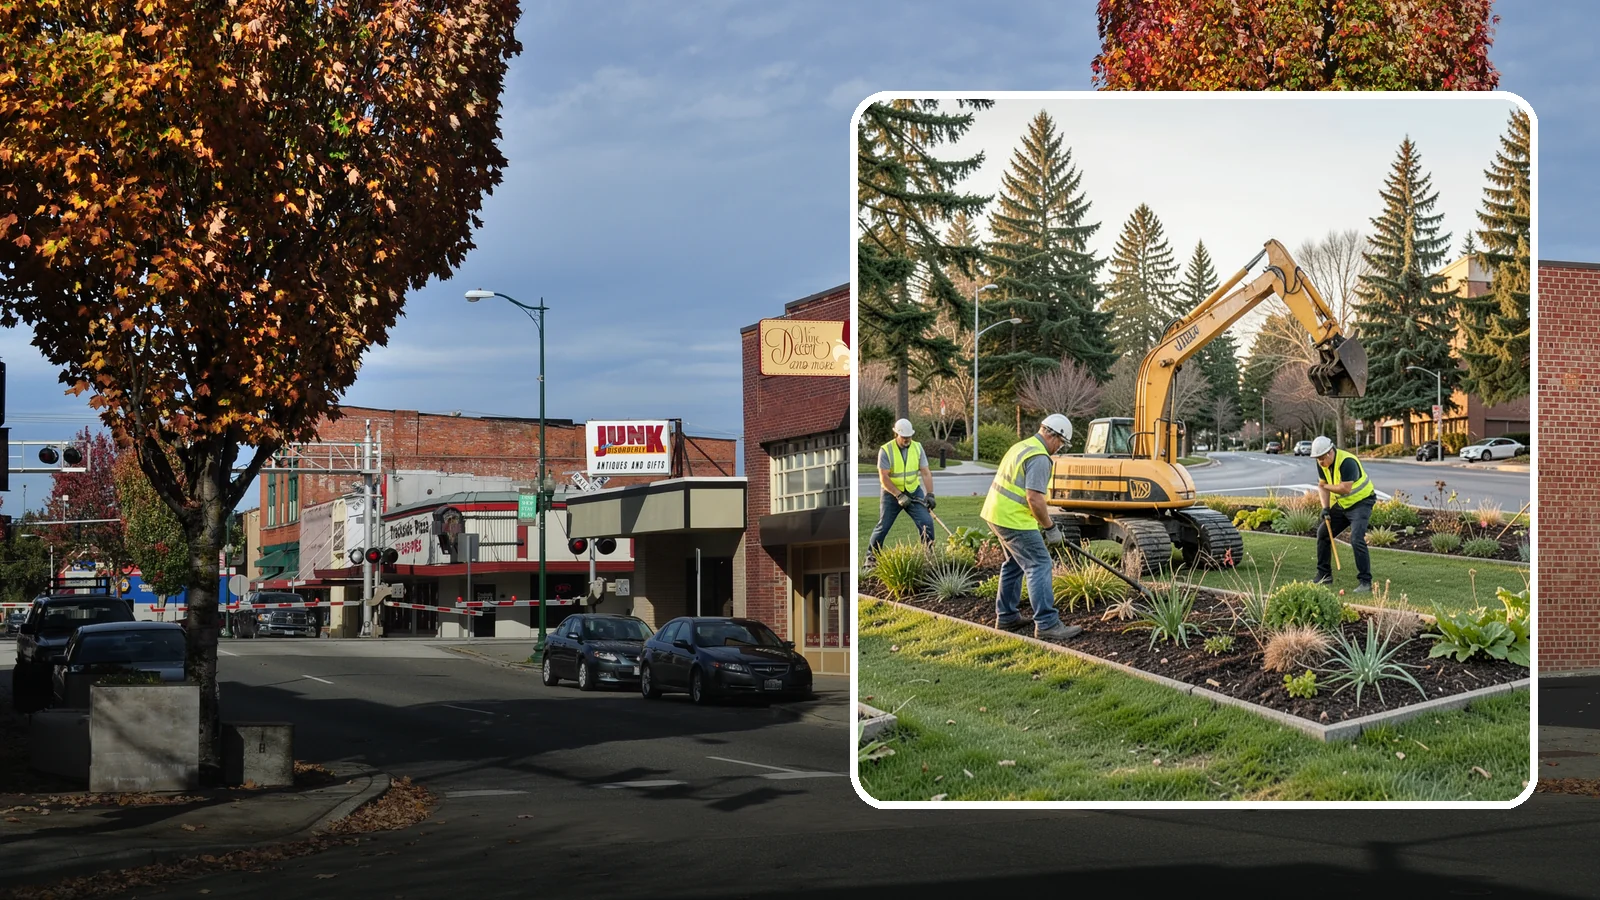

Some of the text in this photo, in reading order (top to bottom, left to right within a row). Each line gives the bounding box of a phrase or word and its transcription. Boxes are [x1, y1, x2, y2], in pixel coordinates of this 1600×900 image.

[595, 425, 665, 457] JUNK
[597, 460, 665, 470] ANTIQUES AND GIFTS
